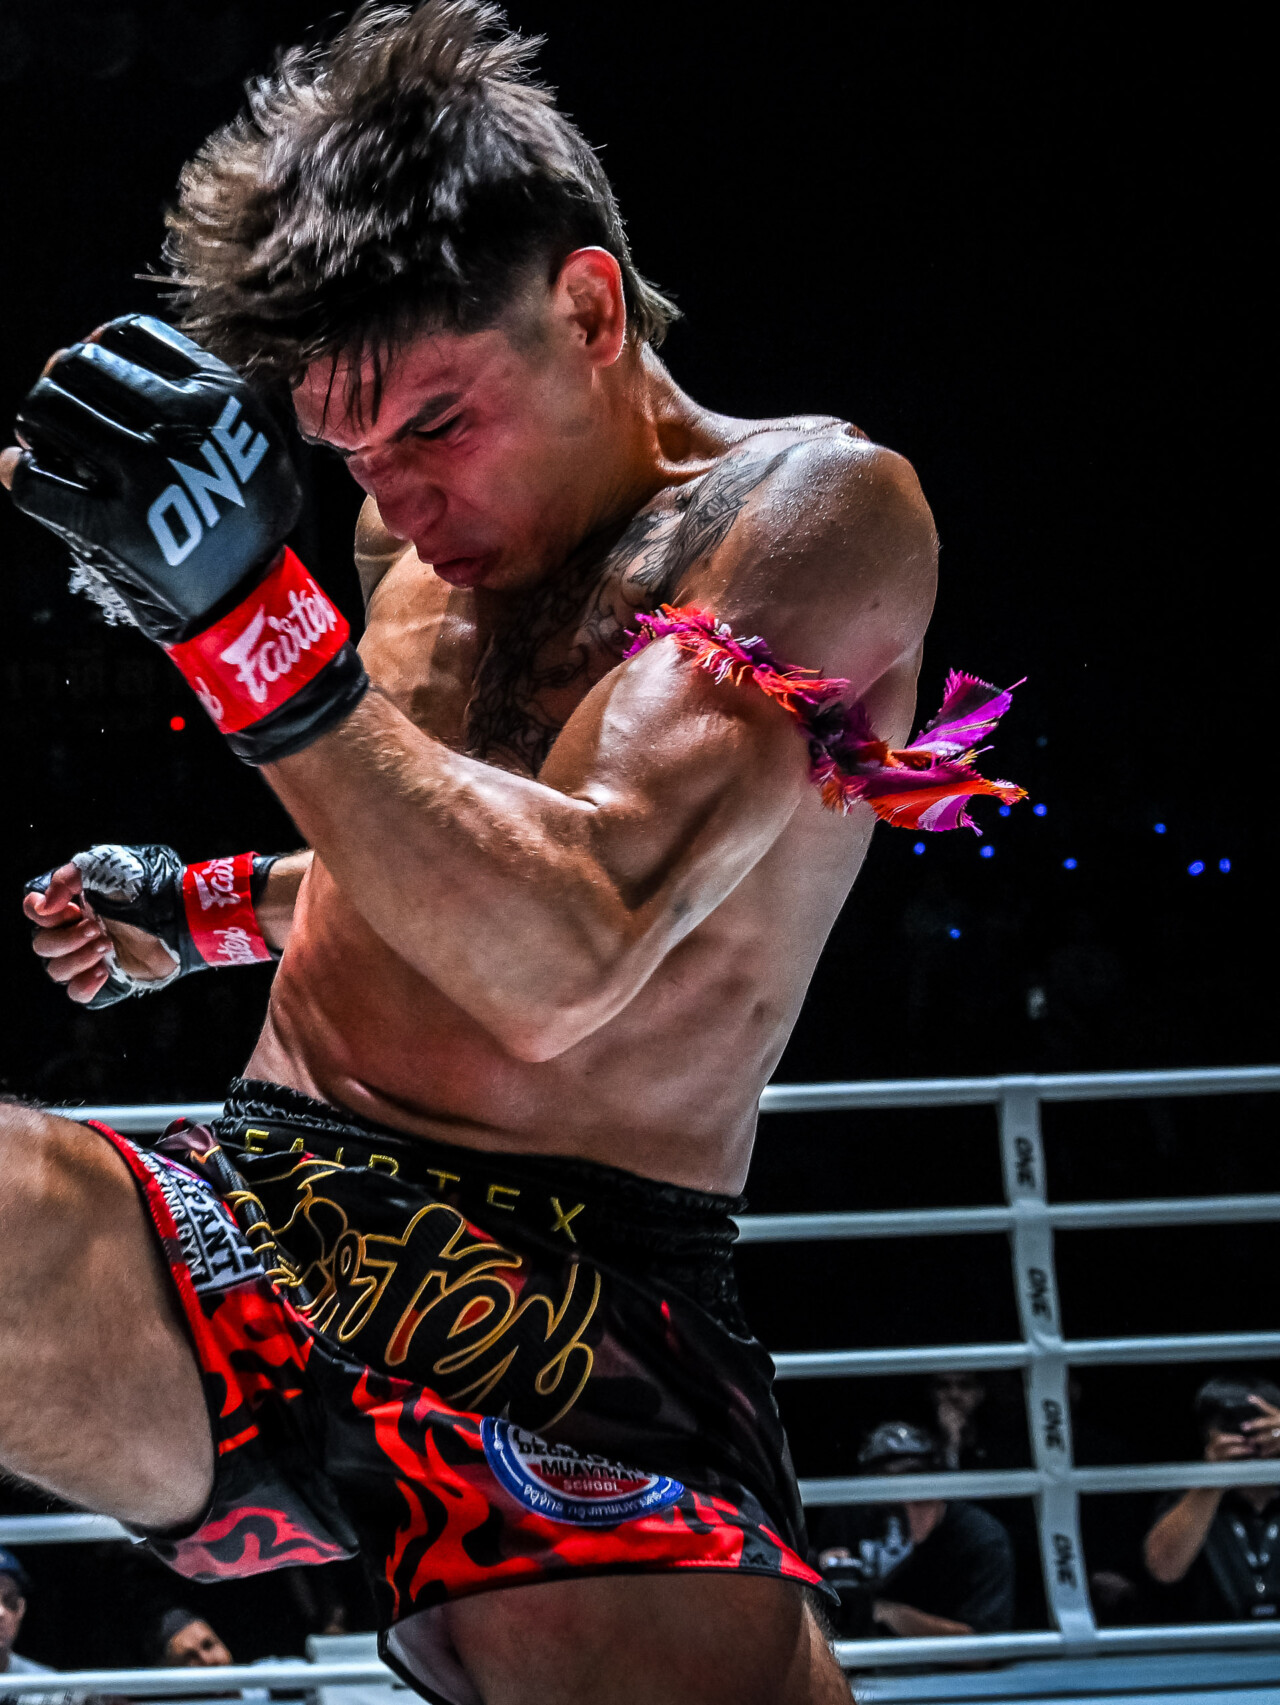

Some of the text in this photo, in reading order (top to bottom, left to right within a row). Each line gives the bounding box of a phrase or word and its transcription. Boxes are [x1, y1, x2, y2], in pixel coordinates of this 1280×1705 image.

[147, 396, 270, 567] ONE
[221, 578, 338, 704] Fairtex
[1014, 1137, 1036, 1188] ONE
[1028, 1267, 1052, 1322] ONE
[1043, 1399, 1065, 1452] ONE
[1053, 1533, 1077, 1589] ONE
